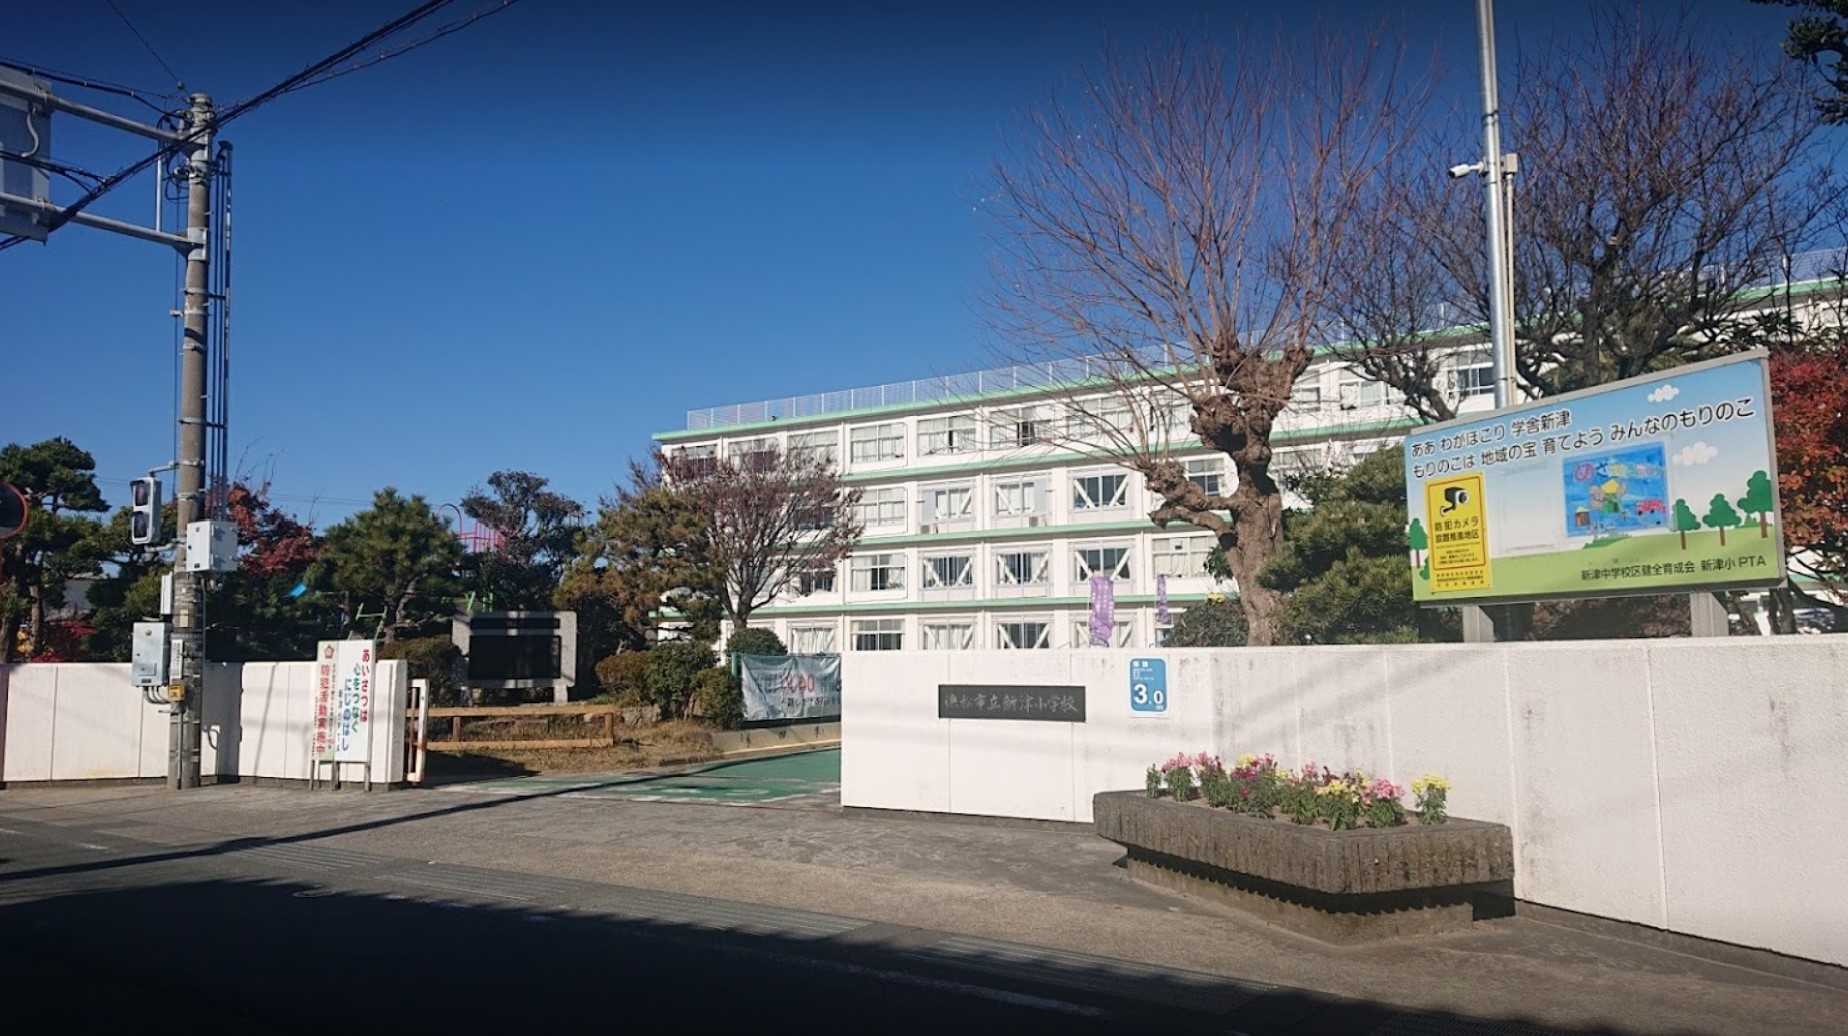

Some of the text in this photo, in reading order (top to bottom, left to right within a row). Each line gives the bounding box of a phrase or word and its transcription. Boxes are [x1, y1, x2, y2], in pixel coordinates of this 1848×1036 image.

[1411, 409, 1571, 458] ああ わがほこり 学舎新津
[1412, 398, 1755, 478] もりのこは 地域の宝 育てよう みんなのもりのこ
[1580, 560, 1696, 581] 新津中学校区健全育成会
[342, 678, 352, 751] にじのはし
[360, 649, 370, 723] あいさつは
[1134, 683, 1164, 705] 3.0
